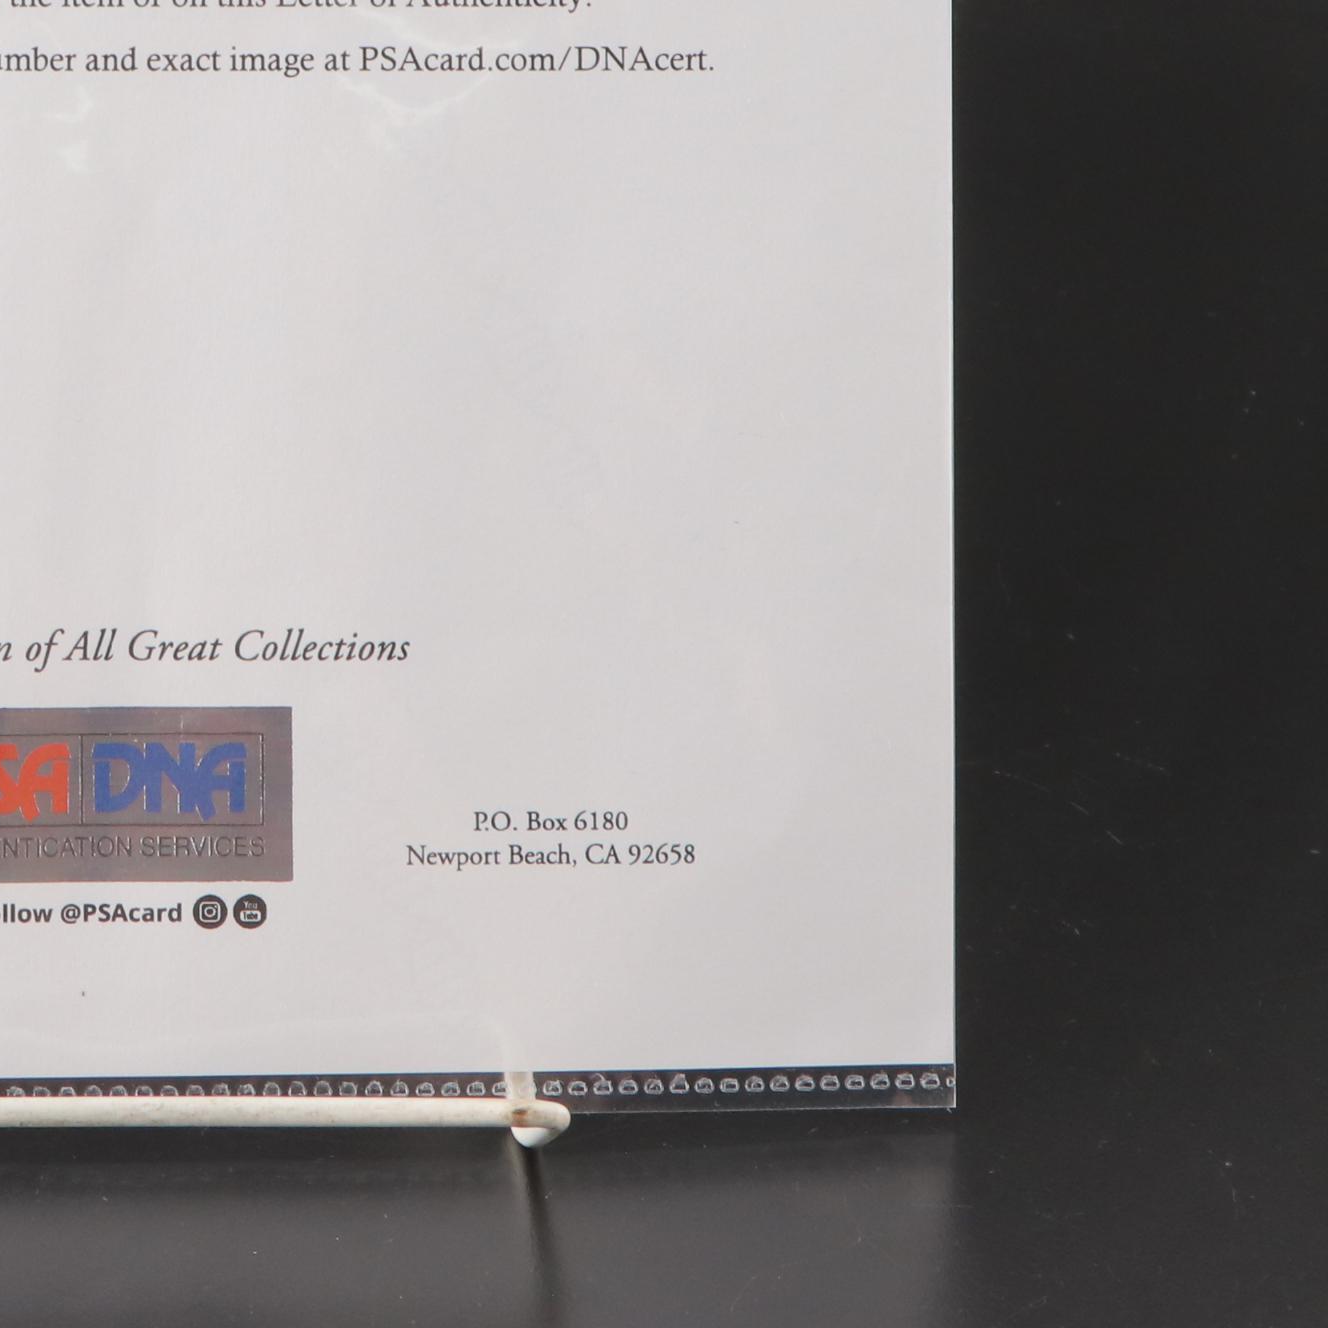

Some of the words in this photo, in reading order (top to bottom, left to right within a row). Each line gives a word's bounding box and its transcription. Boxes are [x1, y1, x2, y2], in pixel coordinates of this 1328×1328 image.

[84, 45, 139, 73] and
[146, 50, 222, 73] exact
[229, 45, 315, 79] image
[324, 50, 351, 72] at
[358, 45, 715, 72] PSAcard.com/DNAcert.
[24, 627, 60, 674] of
[62, 627, 118, 663] All
[127, 628, 224, 662] Great
[234, 627, 411, 662] Collections
[91, 742, 248, 822] DNA
[473, 810, 518, 832] P.O.
[525, 810, 569, 832] Box
[573, 809, 629, 832] 6180
[139, 835, 266, 858] SERVICES
[405, 844, 502, 872] Newport
[508, 842, 578, 868] Beach,
[584, 842, 622, 865] CA
[627, 842, 696, 866] 92658
[60, 902, 183, 925] @PSAcard
